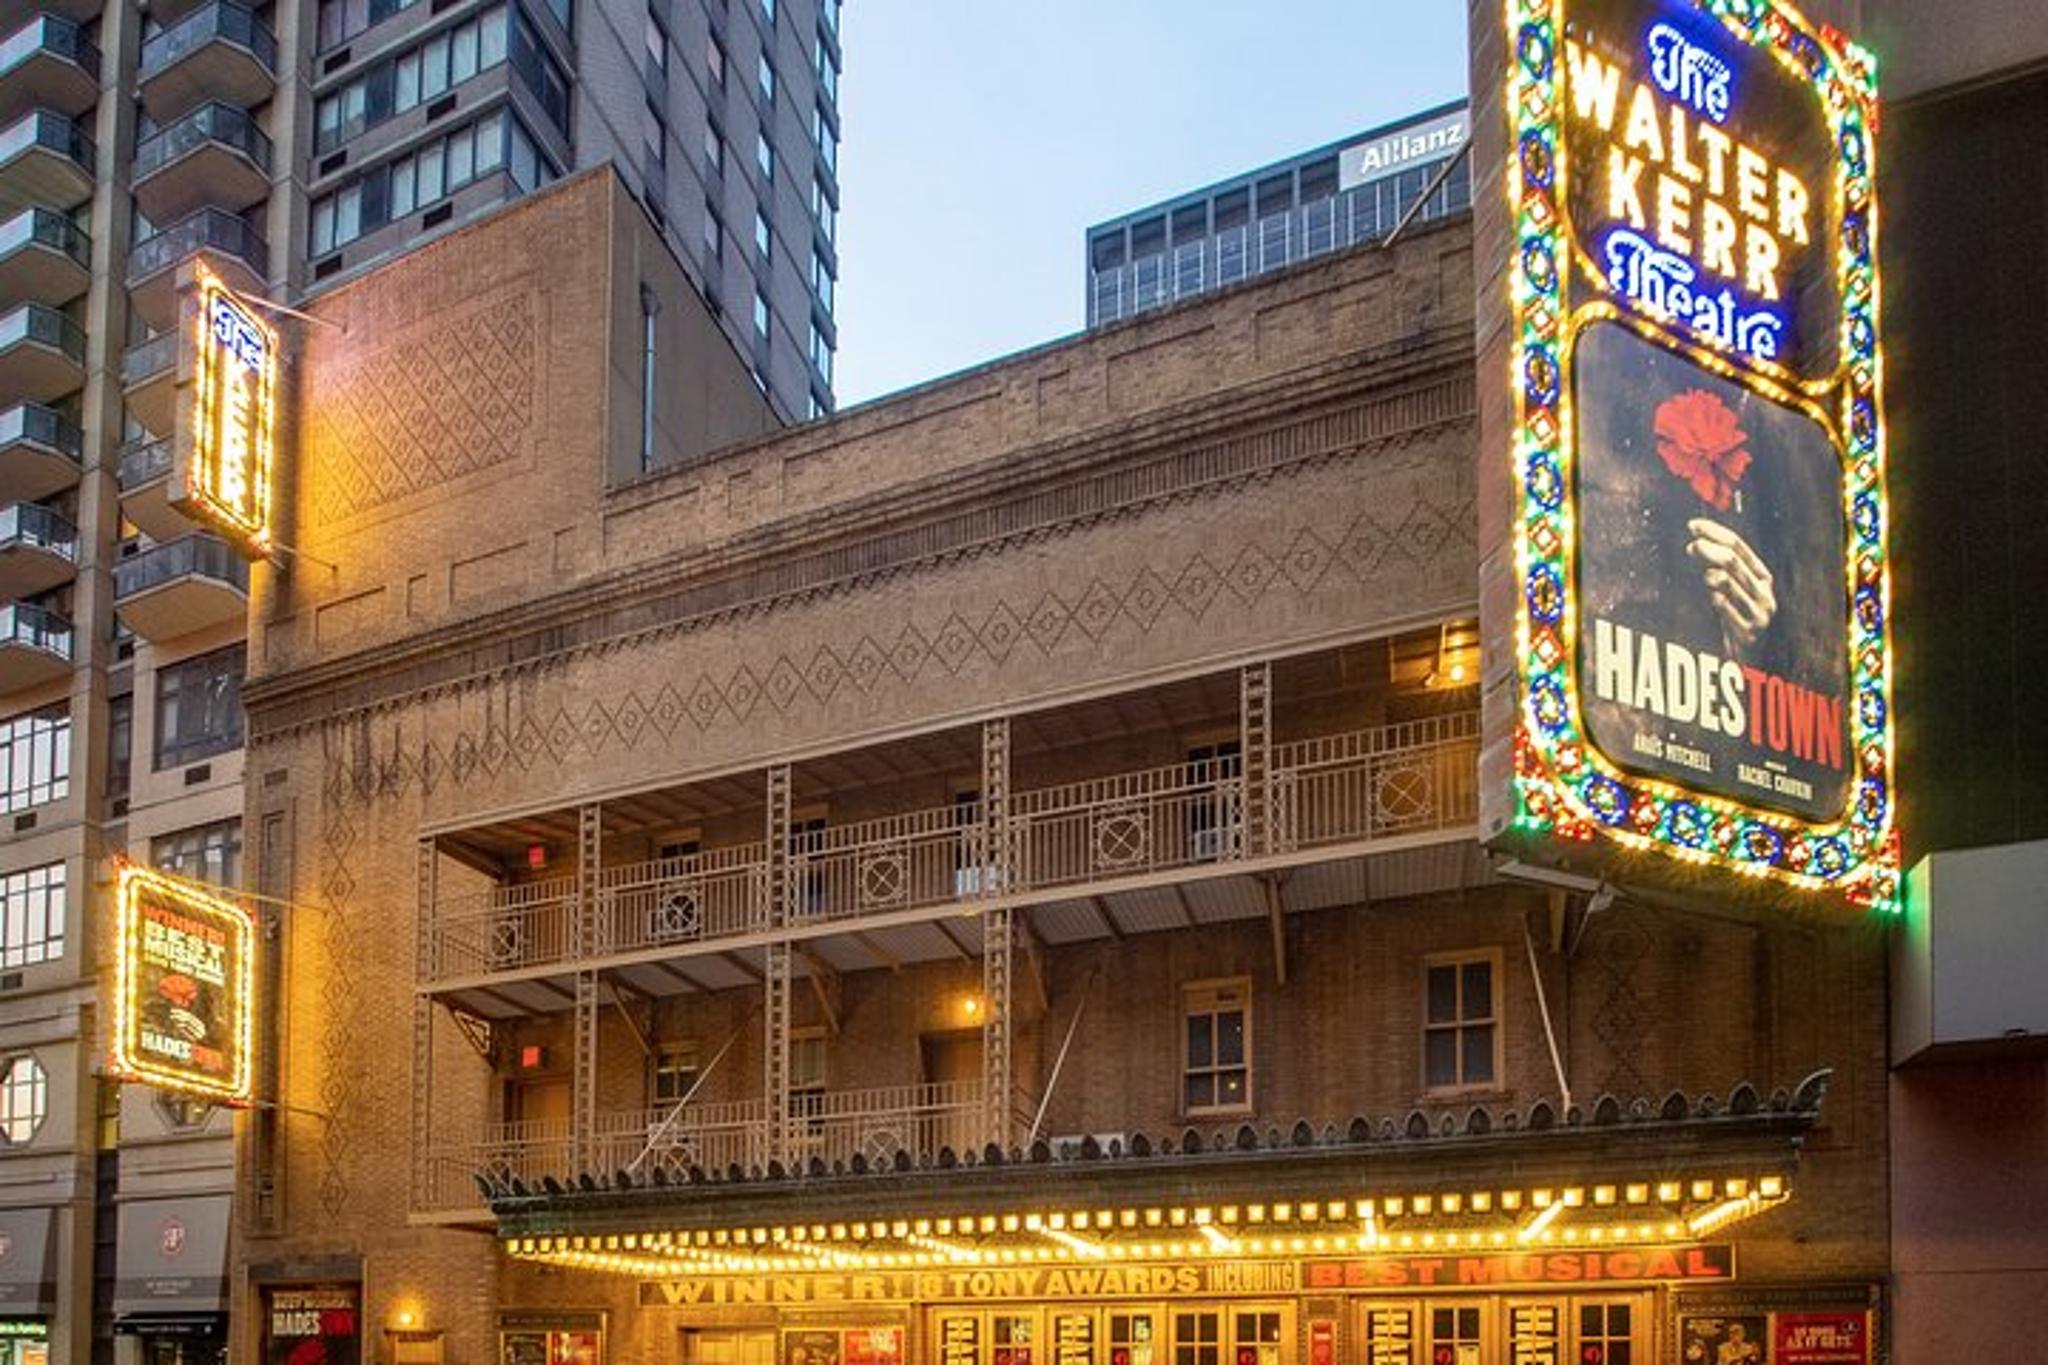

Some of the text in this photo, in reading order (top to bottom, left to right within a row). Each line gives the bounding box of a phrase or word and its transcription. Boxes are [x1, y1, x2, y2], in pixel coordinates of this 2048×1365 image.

[1647, 22, 1731, 123] The
[1361, 122, 1464, 174] Allianz
[1565, 39, 1810, 246] WALTER
[1609, 144, 1780, 301] KERR
[1605, 229, 1783, 360] Theatre
[1594, 618, 1843, 770] HADESTOWN
[948, 1270, 1042, 1297] TONY
[1045, 1267, 1200, 1296] AWARDS
[1207, 1262, 1293, 1292] INCLUDING
[1308, 1251, 1722, 1287] BEST MUSICAL
